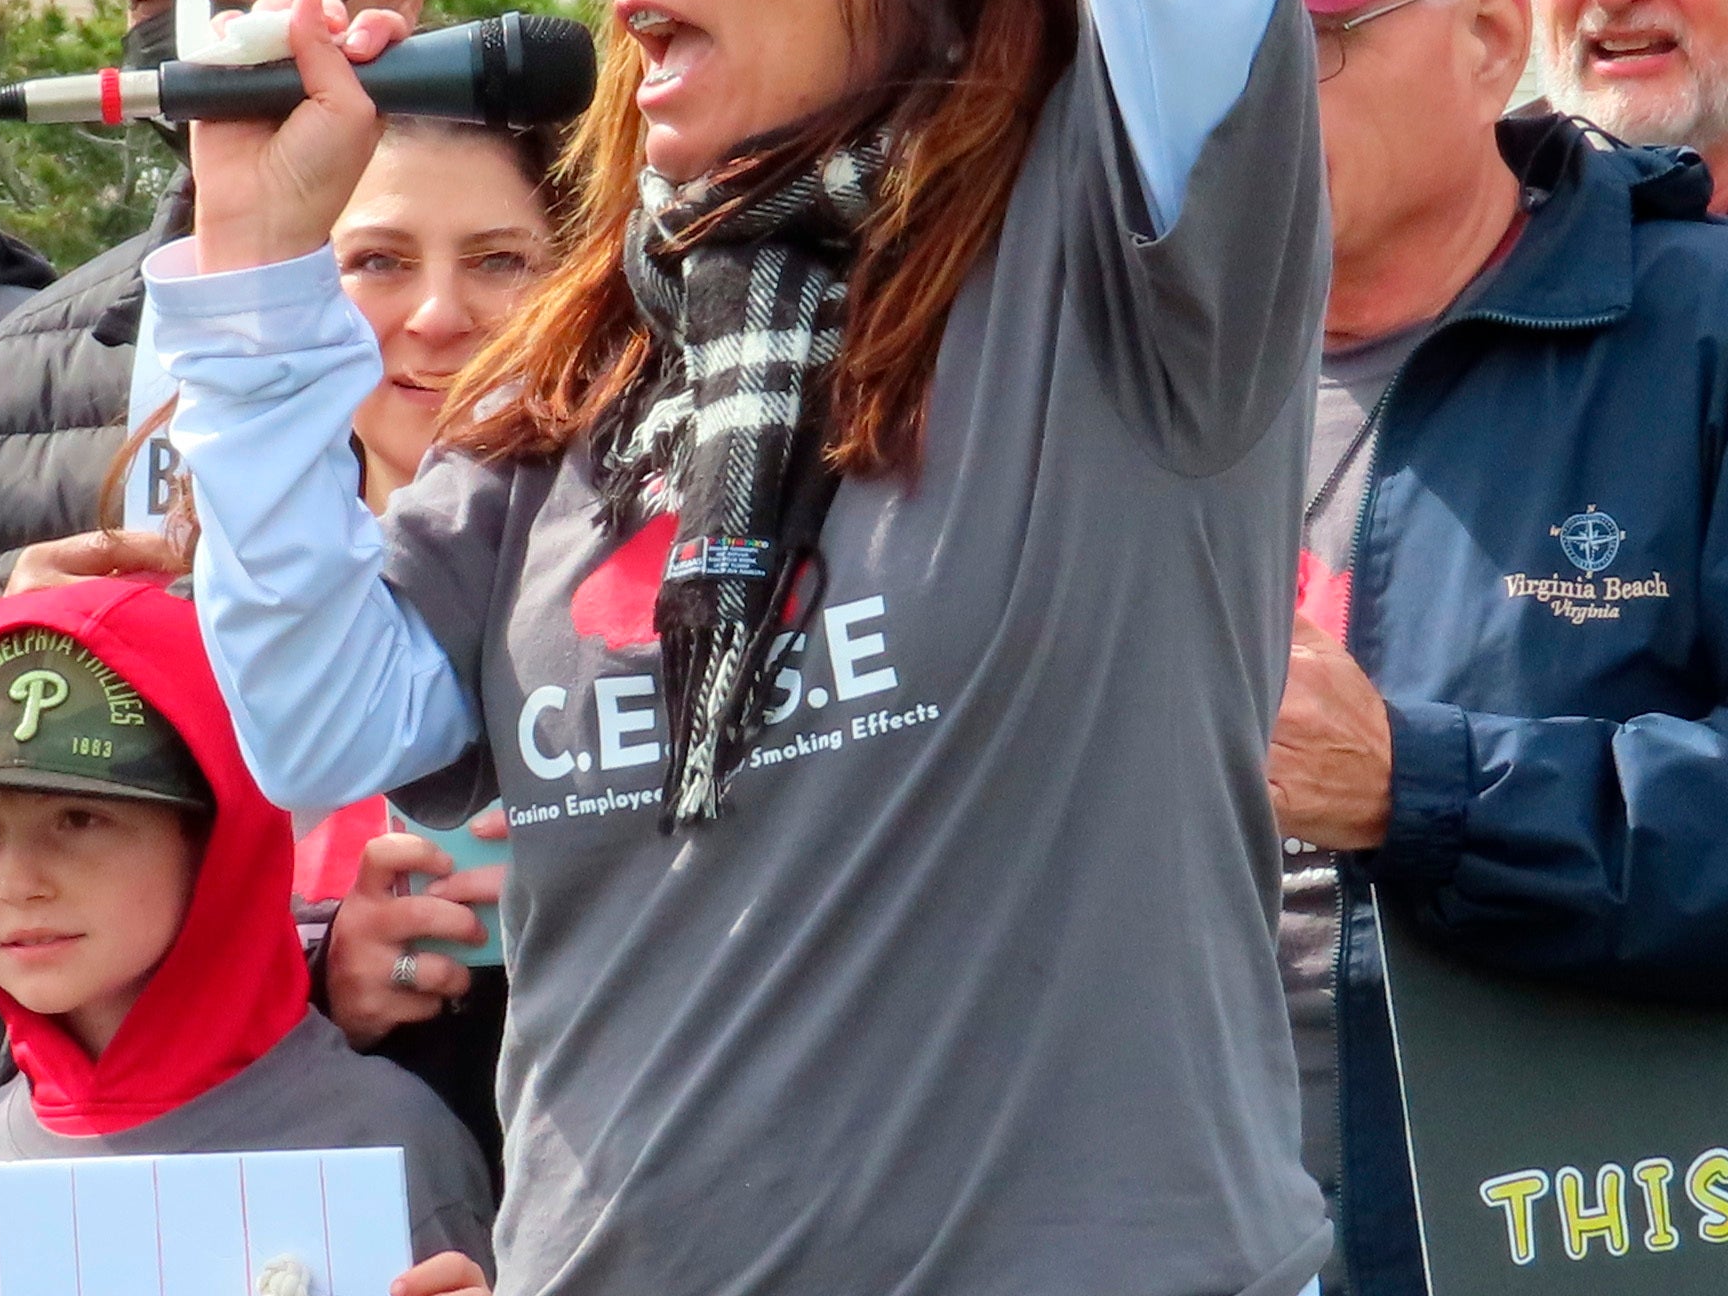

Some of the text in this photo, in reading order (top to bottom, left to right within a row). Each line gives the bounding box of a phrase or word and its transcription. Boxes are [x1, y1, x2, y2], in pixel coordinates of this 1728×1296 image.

[1503, 571, 1670, 602] Virginia Beach
[1551, 599, 1620, 625] Virginia
[8, 668, 70, 742] P
[509, 700, 940, 828] Casino Employee Smoking Effects
